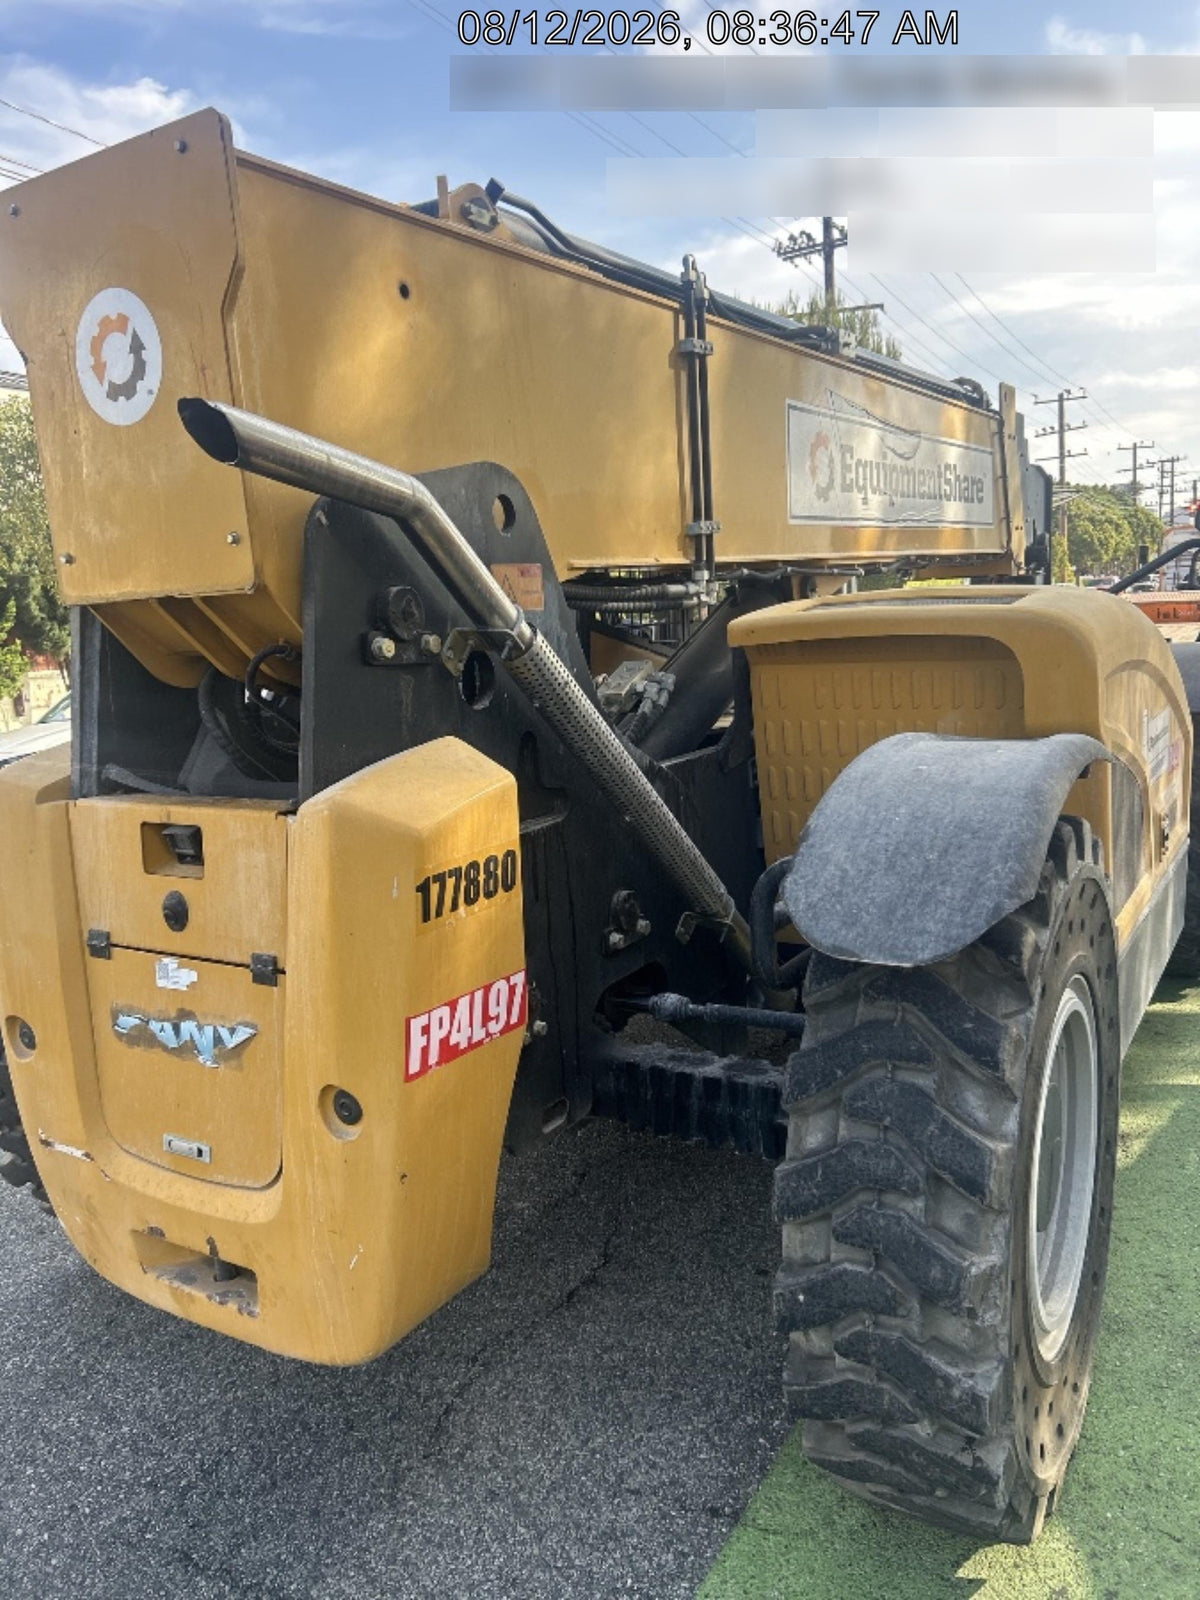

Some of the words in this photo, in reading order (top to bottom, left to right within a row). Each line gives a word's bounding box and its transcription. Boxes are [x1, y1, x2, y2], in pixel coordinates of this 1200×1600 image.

[841, 443, 984, 506] EquipmentShare
[416, 849, 517, 923] 177880
[409, 970, 526, 1076] FP4L97
